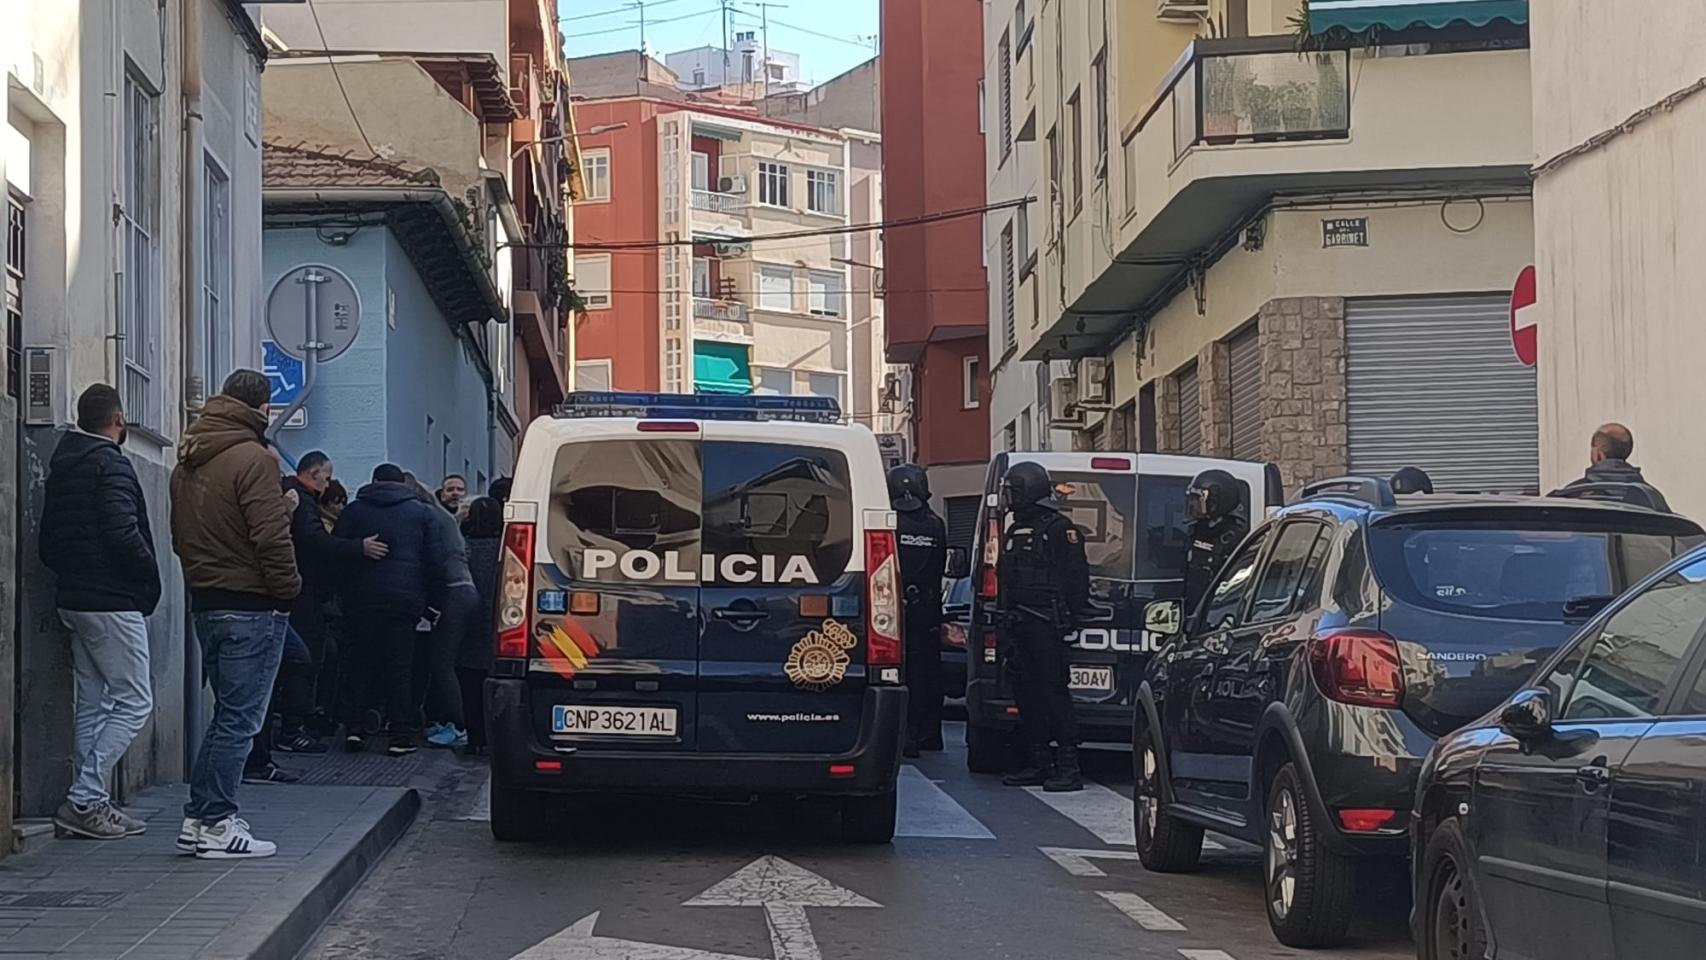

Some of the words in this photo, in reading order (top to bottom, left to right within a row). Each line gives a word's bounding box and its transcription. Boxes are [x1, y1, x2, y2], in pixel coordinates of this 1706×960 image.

[1335, 220, 1360, 228] CALLE
[582, 548, 820, 584] POLICIA
[1416, 652, 1487, 661] SANDERO
[746, 713, 840, 722] www.policia.es
